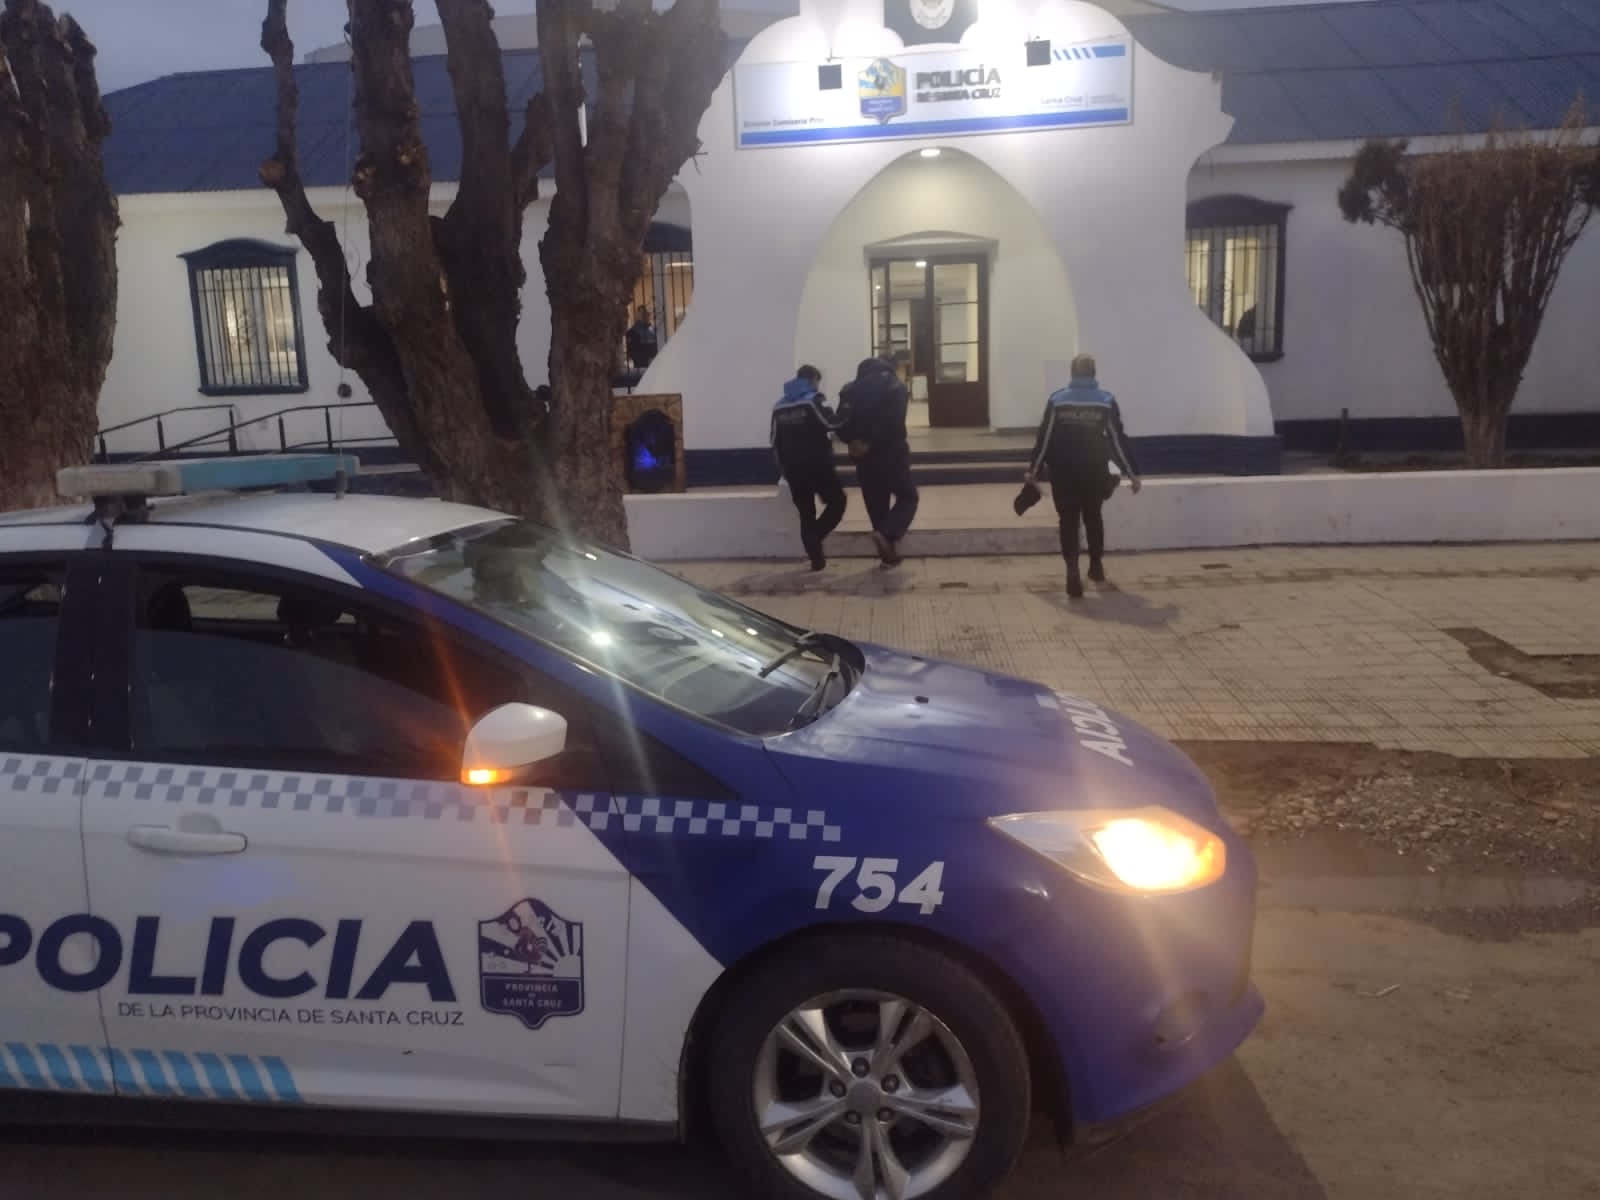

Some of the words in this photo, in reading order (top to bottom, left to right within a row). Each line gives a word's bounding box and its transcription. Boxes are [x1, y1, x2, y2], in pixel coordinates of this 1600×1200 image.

[813, 856, 945, 915] 754
[504, 983, 559, 993] PROVINCIA
[503, 998, 535, 1009] SANTA
[537, 999, 563, 1009] CRUZ
[118, 1002, 144, 1017] DE
[150, 1004, 175, 1018] LA
[181, 1005, 291, 1022] PROVINCIA
[297, 1009, 326, 1024] DE
[330, 1010, 401, 1025] SANTA
[406, 1010, 464, 1026] CRUZ
